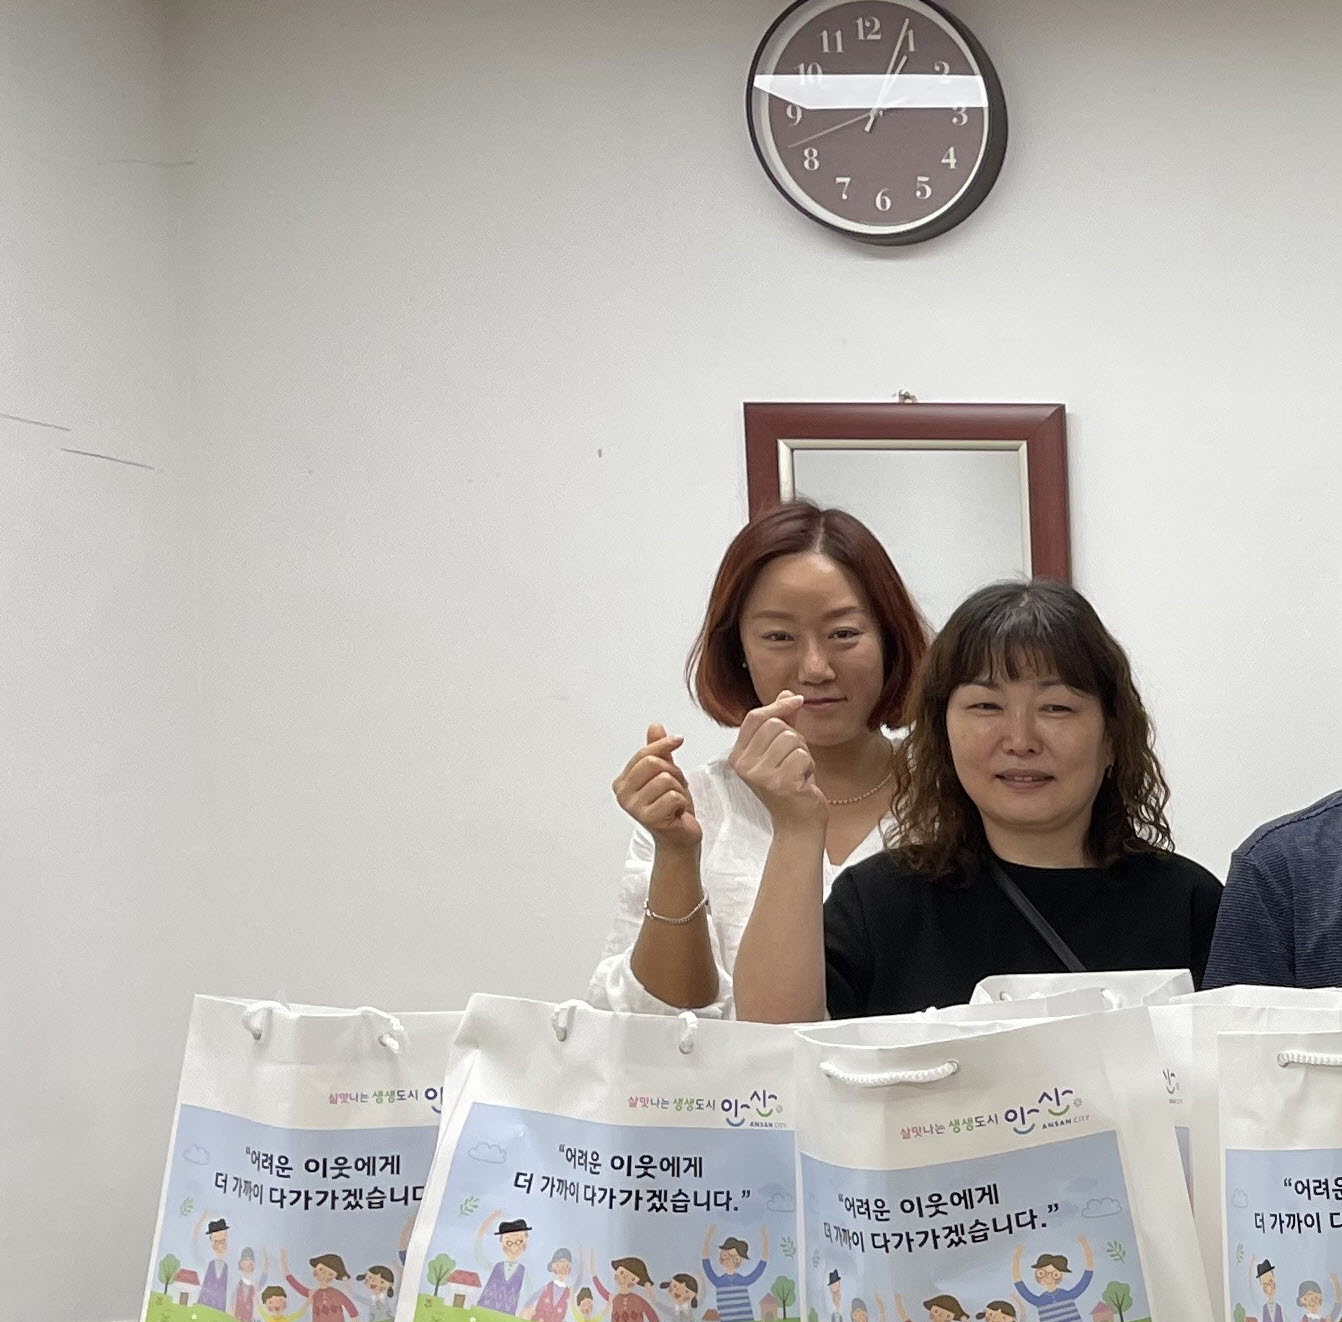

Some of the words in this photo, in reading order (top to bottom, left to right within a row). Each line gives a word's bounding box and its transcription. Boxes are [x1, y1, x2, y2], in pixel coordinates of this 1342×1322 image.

[856, 16, 882, 41] 12
[820, 30, 844, 53] 11
[904, 30, 916, 52] 1
[803, 147, 820, 171] 8
[941, 146, 957, 170] 4
[835, 177, 852, 200] 7
[875, 188, 892, 212] 6
[916, 176, 932, 200] 5
[372, 1088, 418, 1104] 생생도시
[628, 1096, 669, 1110] 살맛나는
[673, 1096, 716, 1112] 생생도시
[900, 1122, 946, 1141] 살맛나는
[948, 1112, 999, 1134] 생생도시
[1042, 1118, 1072, 1130] ANSAN
[304, 1154, 401, 1179] 이웃에게
[610, 1154, 703, 1179] 이웃에게
[214, 1172, 228, 1193] 더
[233, 1175, 263, 1205] 가까이
[513, 1171, 534, 1195] 더
[540, 1175, 580, 1204] 가까이
[900, 1183, 1000, 1217] 이웃에게
[1254, 1211, 1266, 1235] 더
[1269, 1208, 1322, 1235] 가까이
[823, 1222, 833, 1241] 더
[834, 1225, 865, 1253] 가까이
